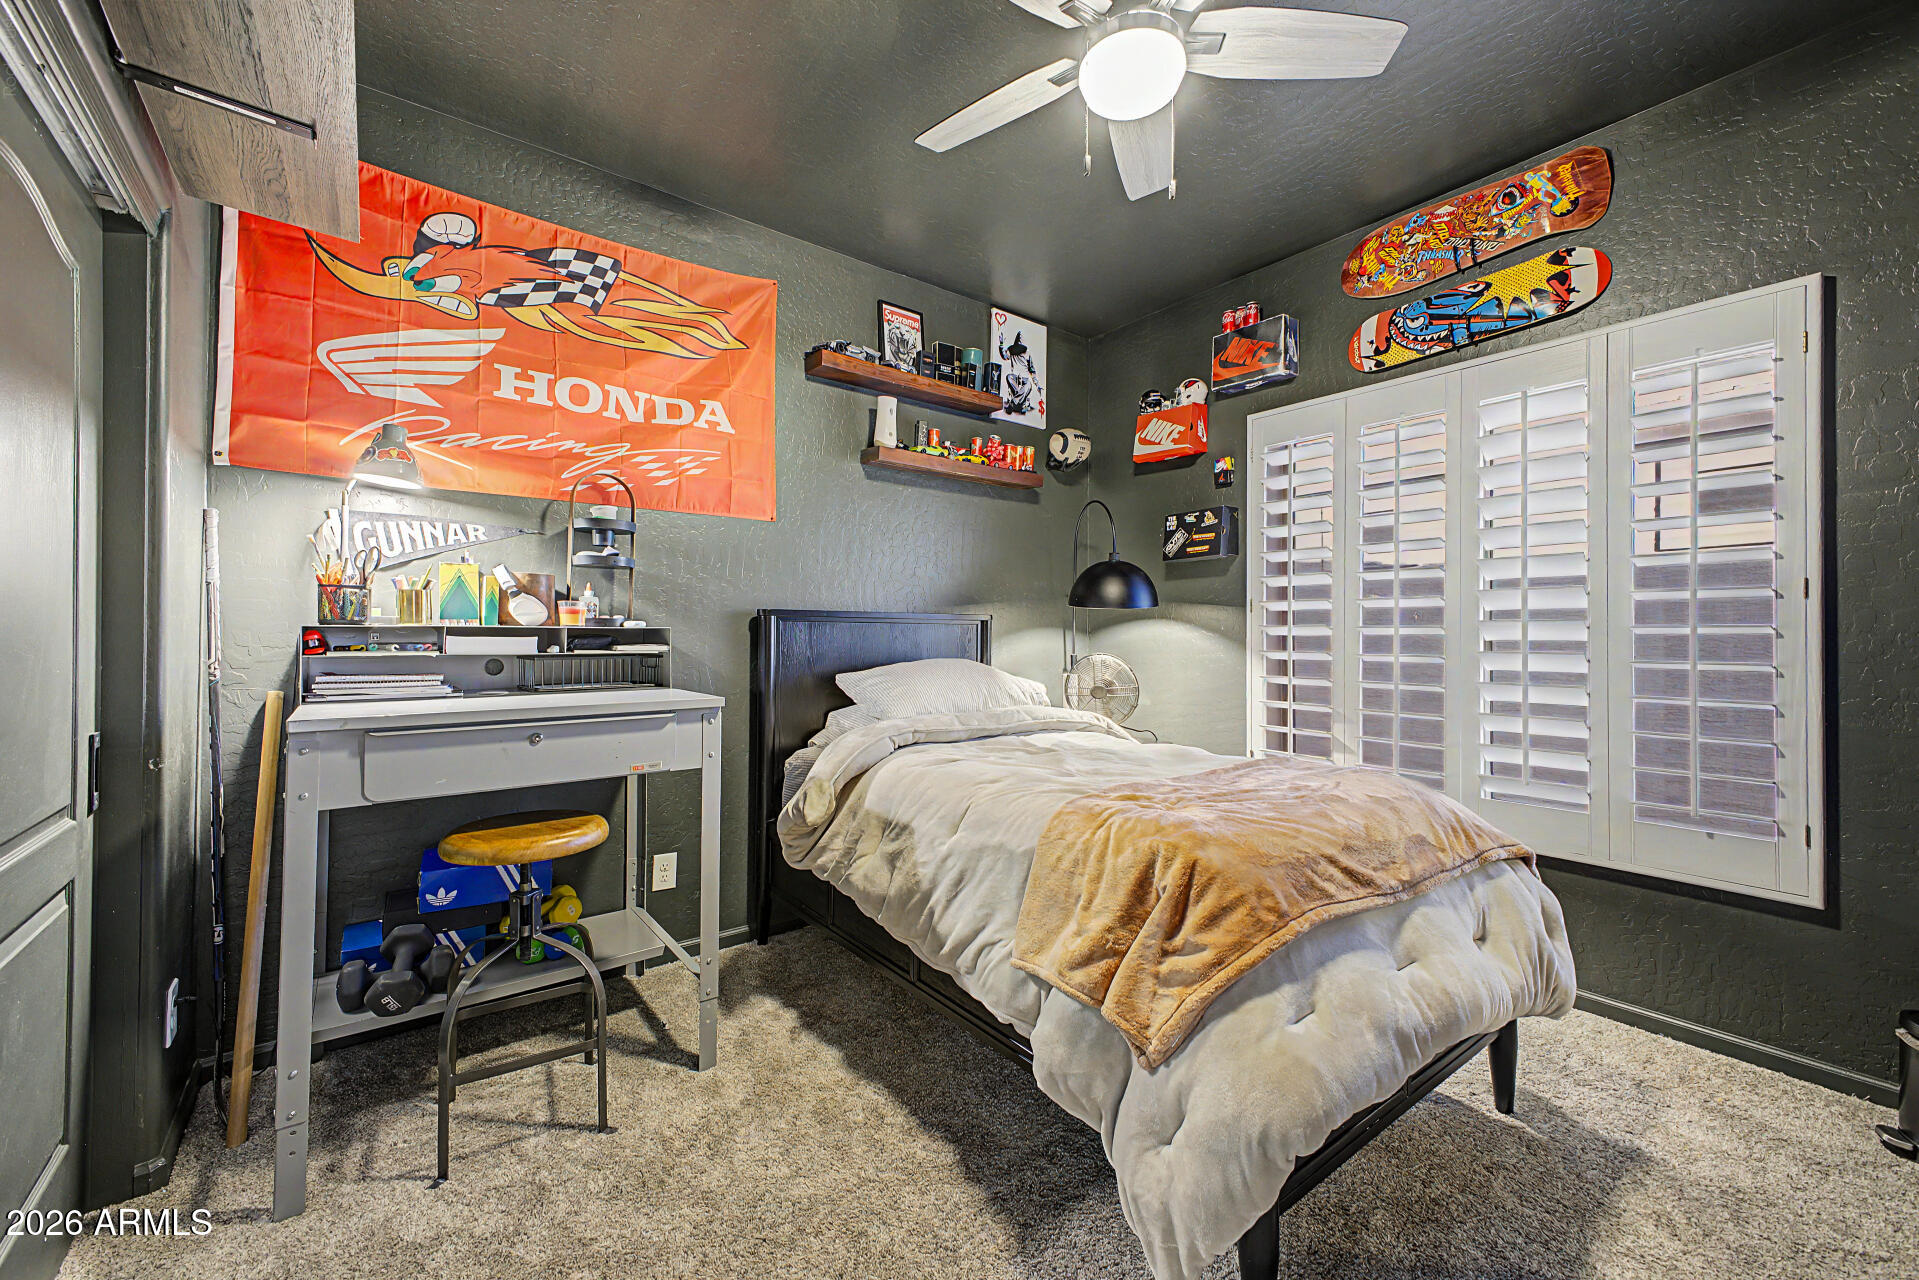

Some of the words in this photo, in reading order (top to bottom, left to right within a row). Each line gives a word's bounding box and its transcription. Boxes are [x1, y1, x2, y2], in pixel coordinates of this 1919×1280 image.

[1221, 337, 1275, 368] NIKE
[493, 362, 735, 435] HONDA
[338, 408, 631, 479] Racing
[1140, 417, 1186, 446] NIKE
[352, 519, 488, 558] GUNNAR
